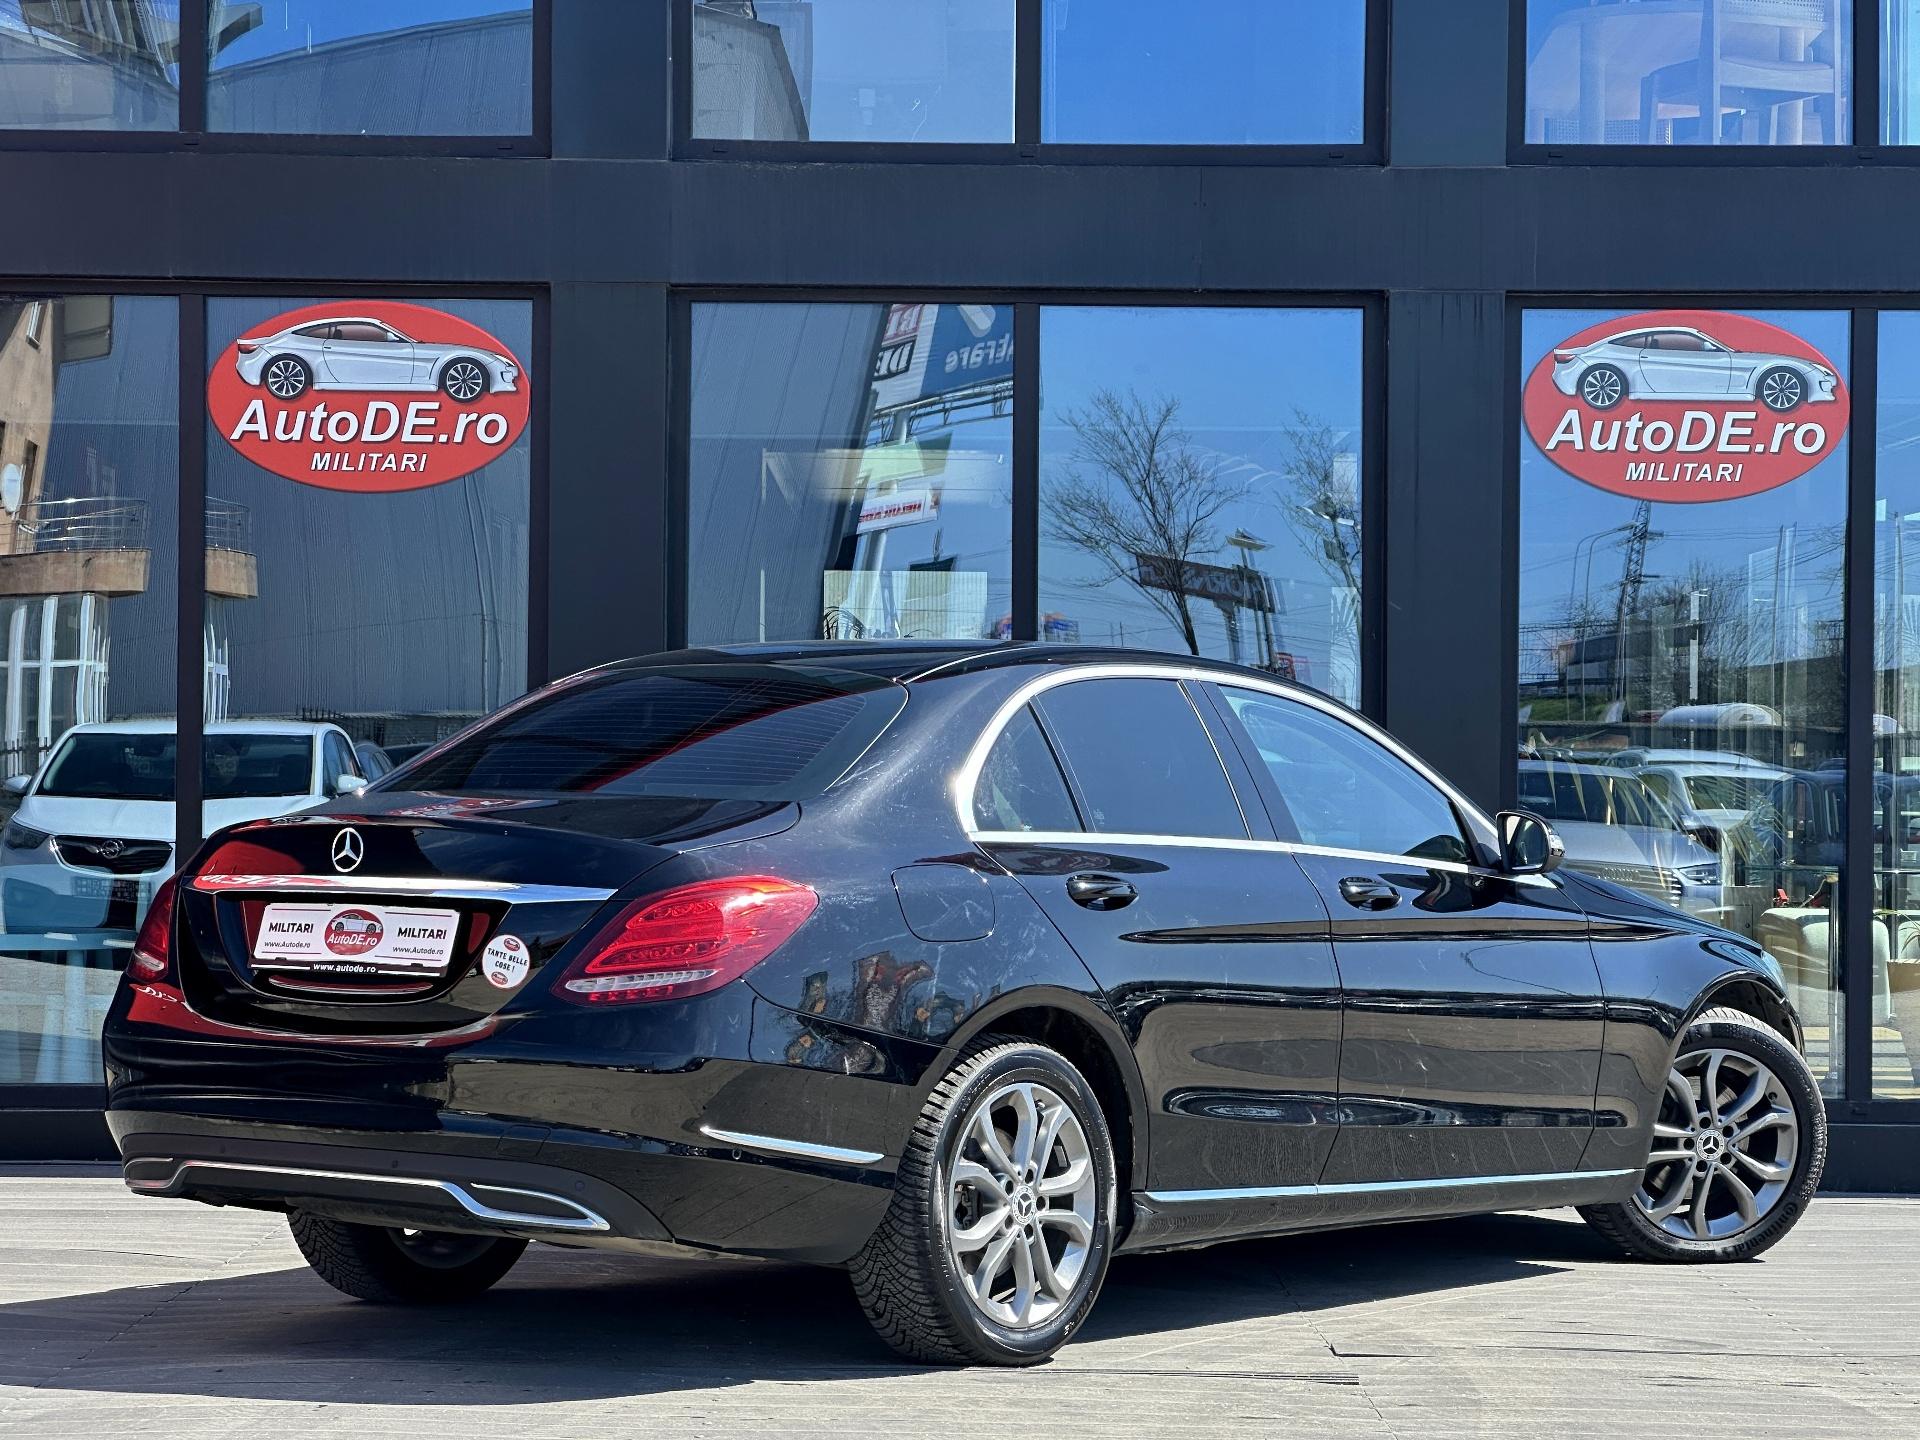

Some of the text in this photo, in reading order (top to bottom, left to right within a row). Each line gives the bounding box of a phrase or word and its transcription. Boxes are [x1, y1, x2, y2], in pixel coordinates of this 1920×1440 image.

[230, 399, 508, 444] AutoDE.ro
[1545, 409, 1825, 454] AutoDE.ro
[310, 452, 427, 472] MILITARI
[1626, 462, 1743, 482] MILITARI
[268, 922, 314, 933] MILITARI
[397, 927, 447, 940] MILITARI
[326, 932, 378, 946] AutoDE.ro
[392, 946, 444, 955] www.Autode.ro
[487, 948, 528, 966] TANTE BELLE
[313, 963, 376, 973] www.autode.ro
